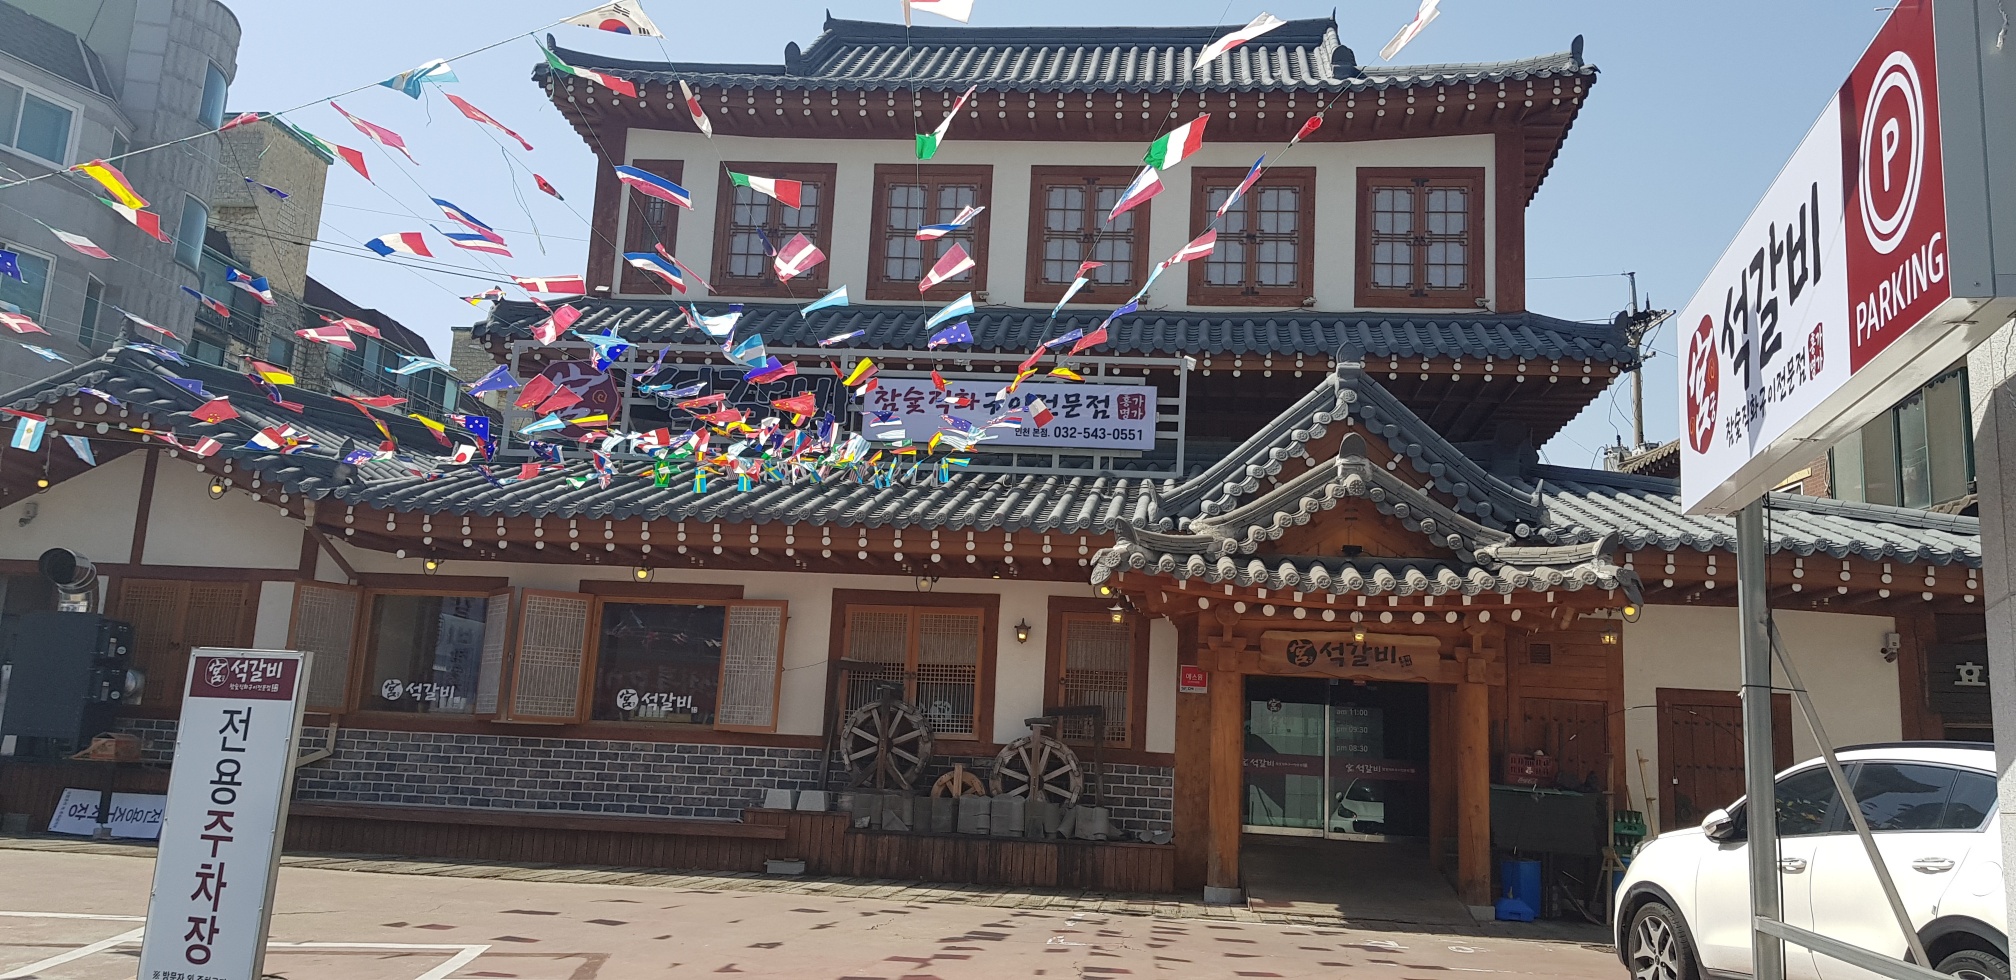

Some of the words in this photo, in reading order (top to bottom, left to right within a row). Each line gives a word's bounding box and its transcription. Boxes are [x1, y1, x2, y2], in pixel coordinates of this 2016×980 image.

[1881, 117, 1899, 192] P
[1721, 181, 1822, 391] 석갈비
[1856, 231, 1944, 348] PARKING
[1120, 394, 1144, 407] 홍가
[1726, 346, 1807, 448] 참숯직화구이전문점
[1119, 407, 1144, 420] 명가
[1015, 427, 1030, 437] 인천
[1054, 426, 1143, 441] 032-543-0551
[1320, 641, 1396, 667] 석갈비
[231, 659, 283, 683] 석갈비
[1954, 661, 1987, 687] 효
[406, 682, 455, 701] 석갈비
[641, 692, 692, 711] 석갈비
[1350, 708, 1368, 716] 11:00
[1356, 764, 1381, 774] 석갈비
[184, 706, 252, 965] 전용주차장
